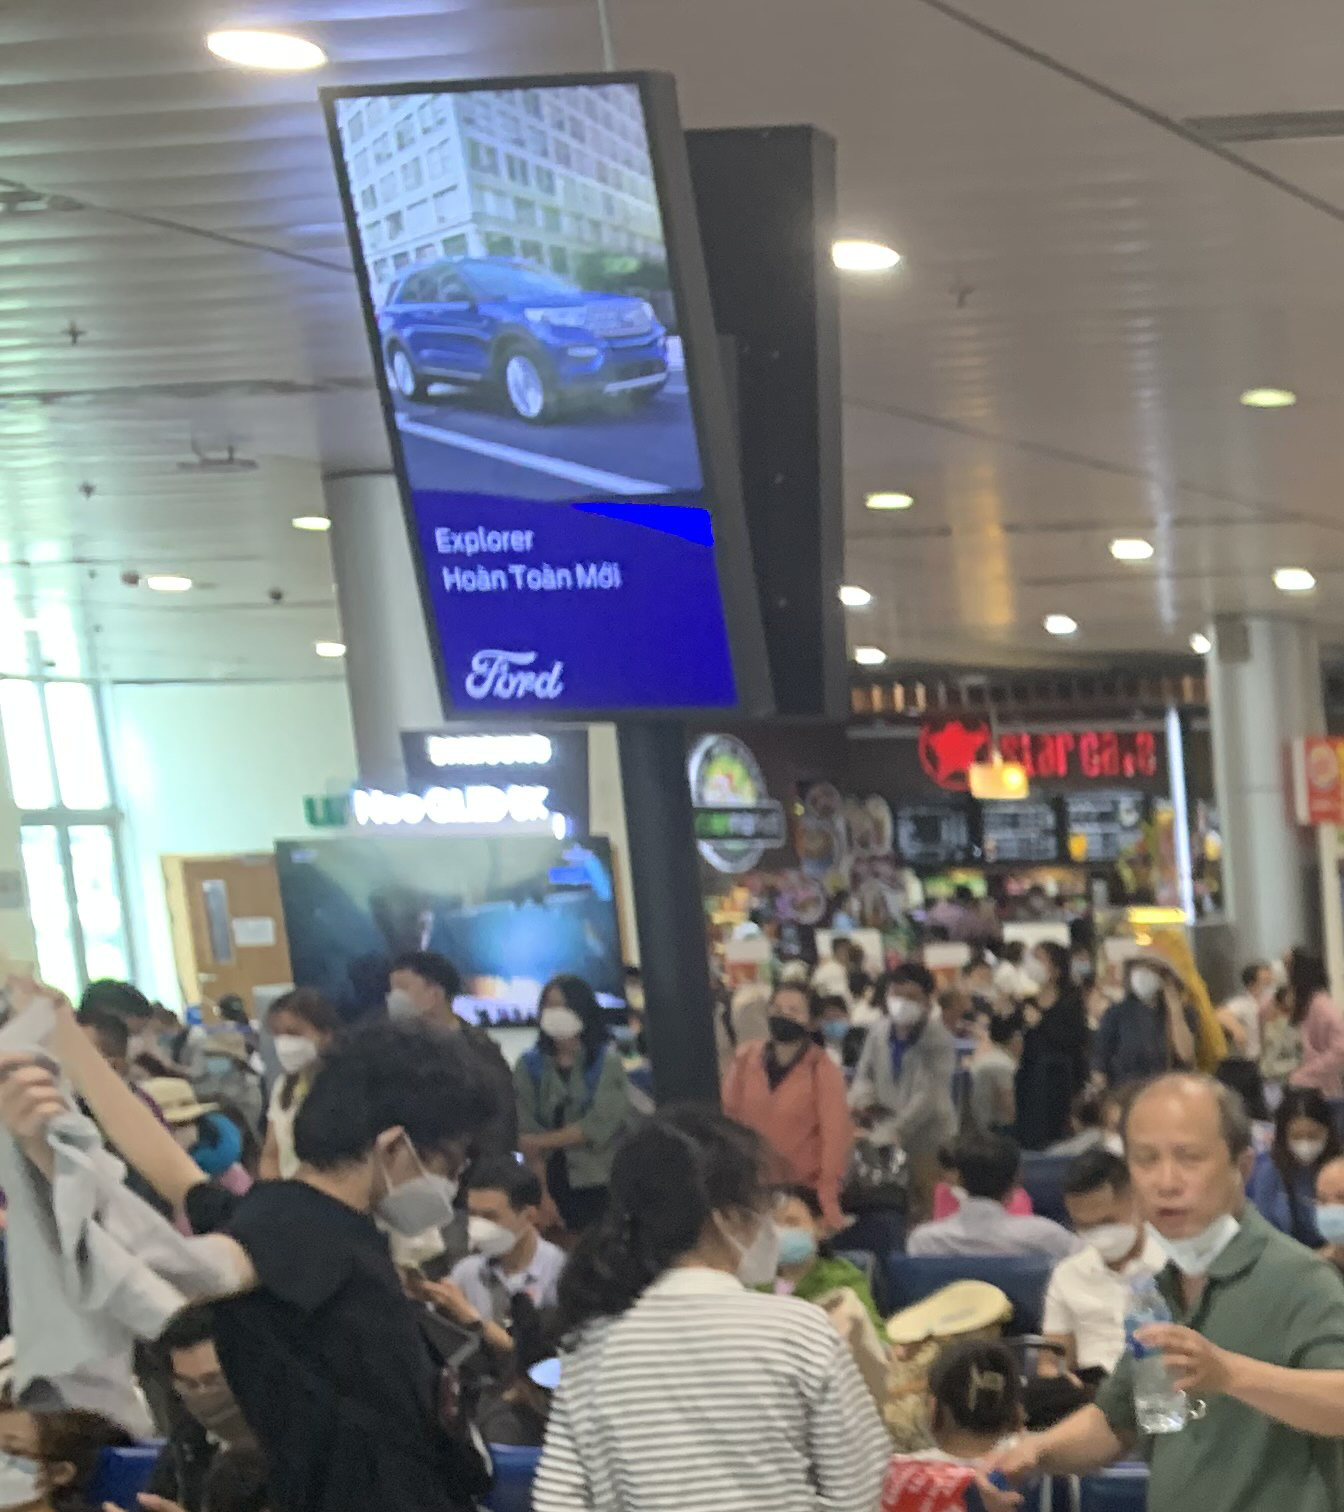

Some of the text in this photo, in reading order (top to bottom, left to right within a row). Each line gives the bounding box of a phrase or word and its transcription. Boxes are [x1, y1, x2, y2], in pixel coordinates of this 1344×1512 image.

[434, 526, 534, 556] Explorer
[442, 564, 508, 592] Hoàn
[508, 562, 572, 592] Toàn
[465, 648, 564, 699] Ford
